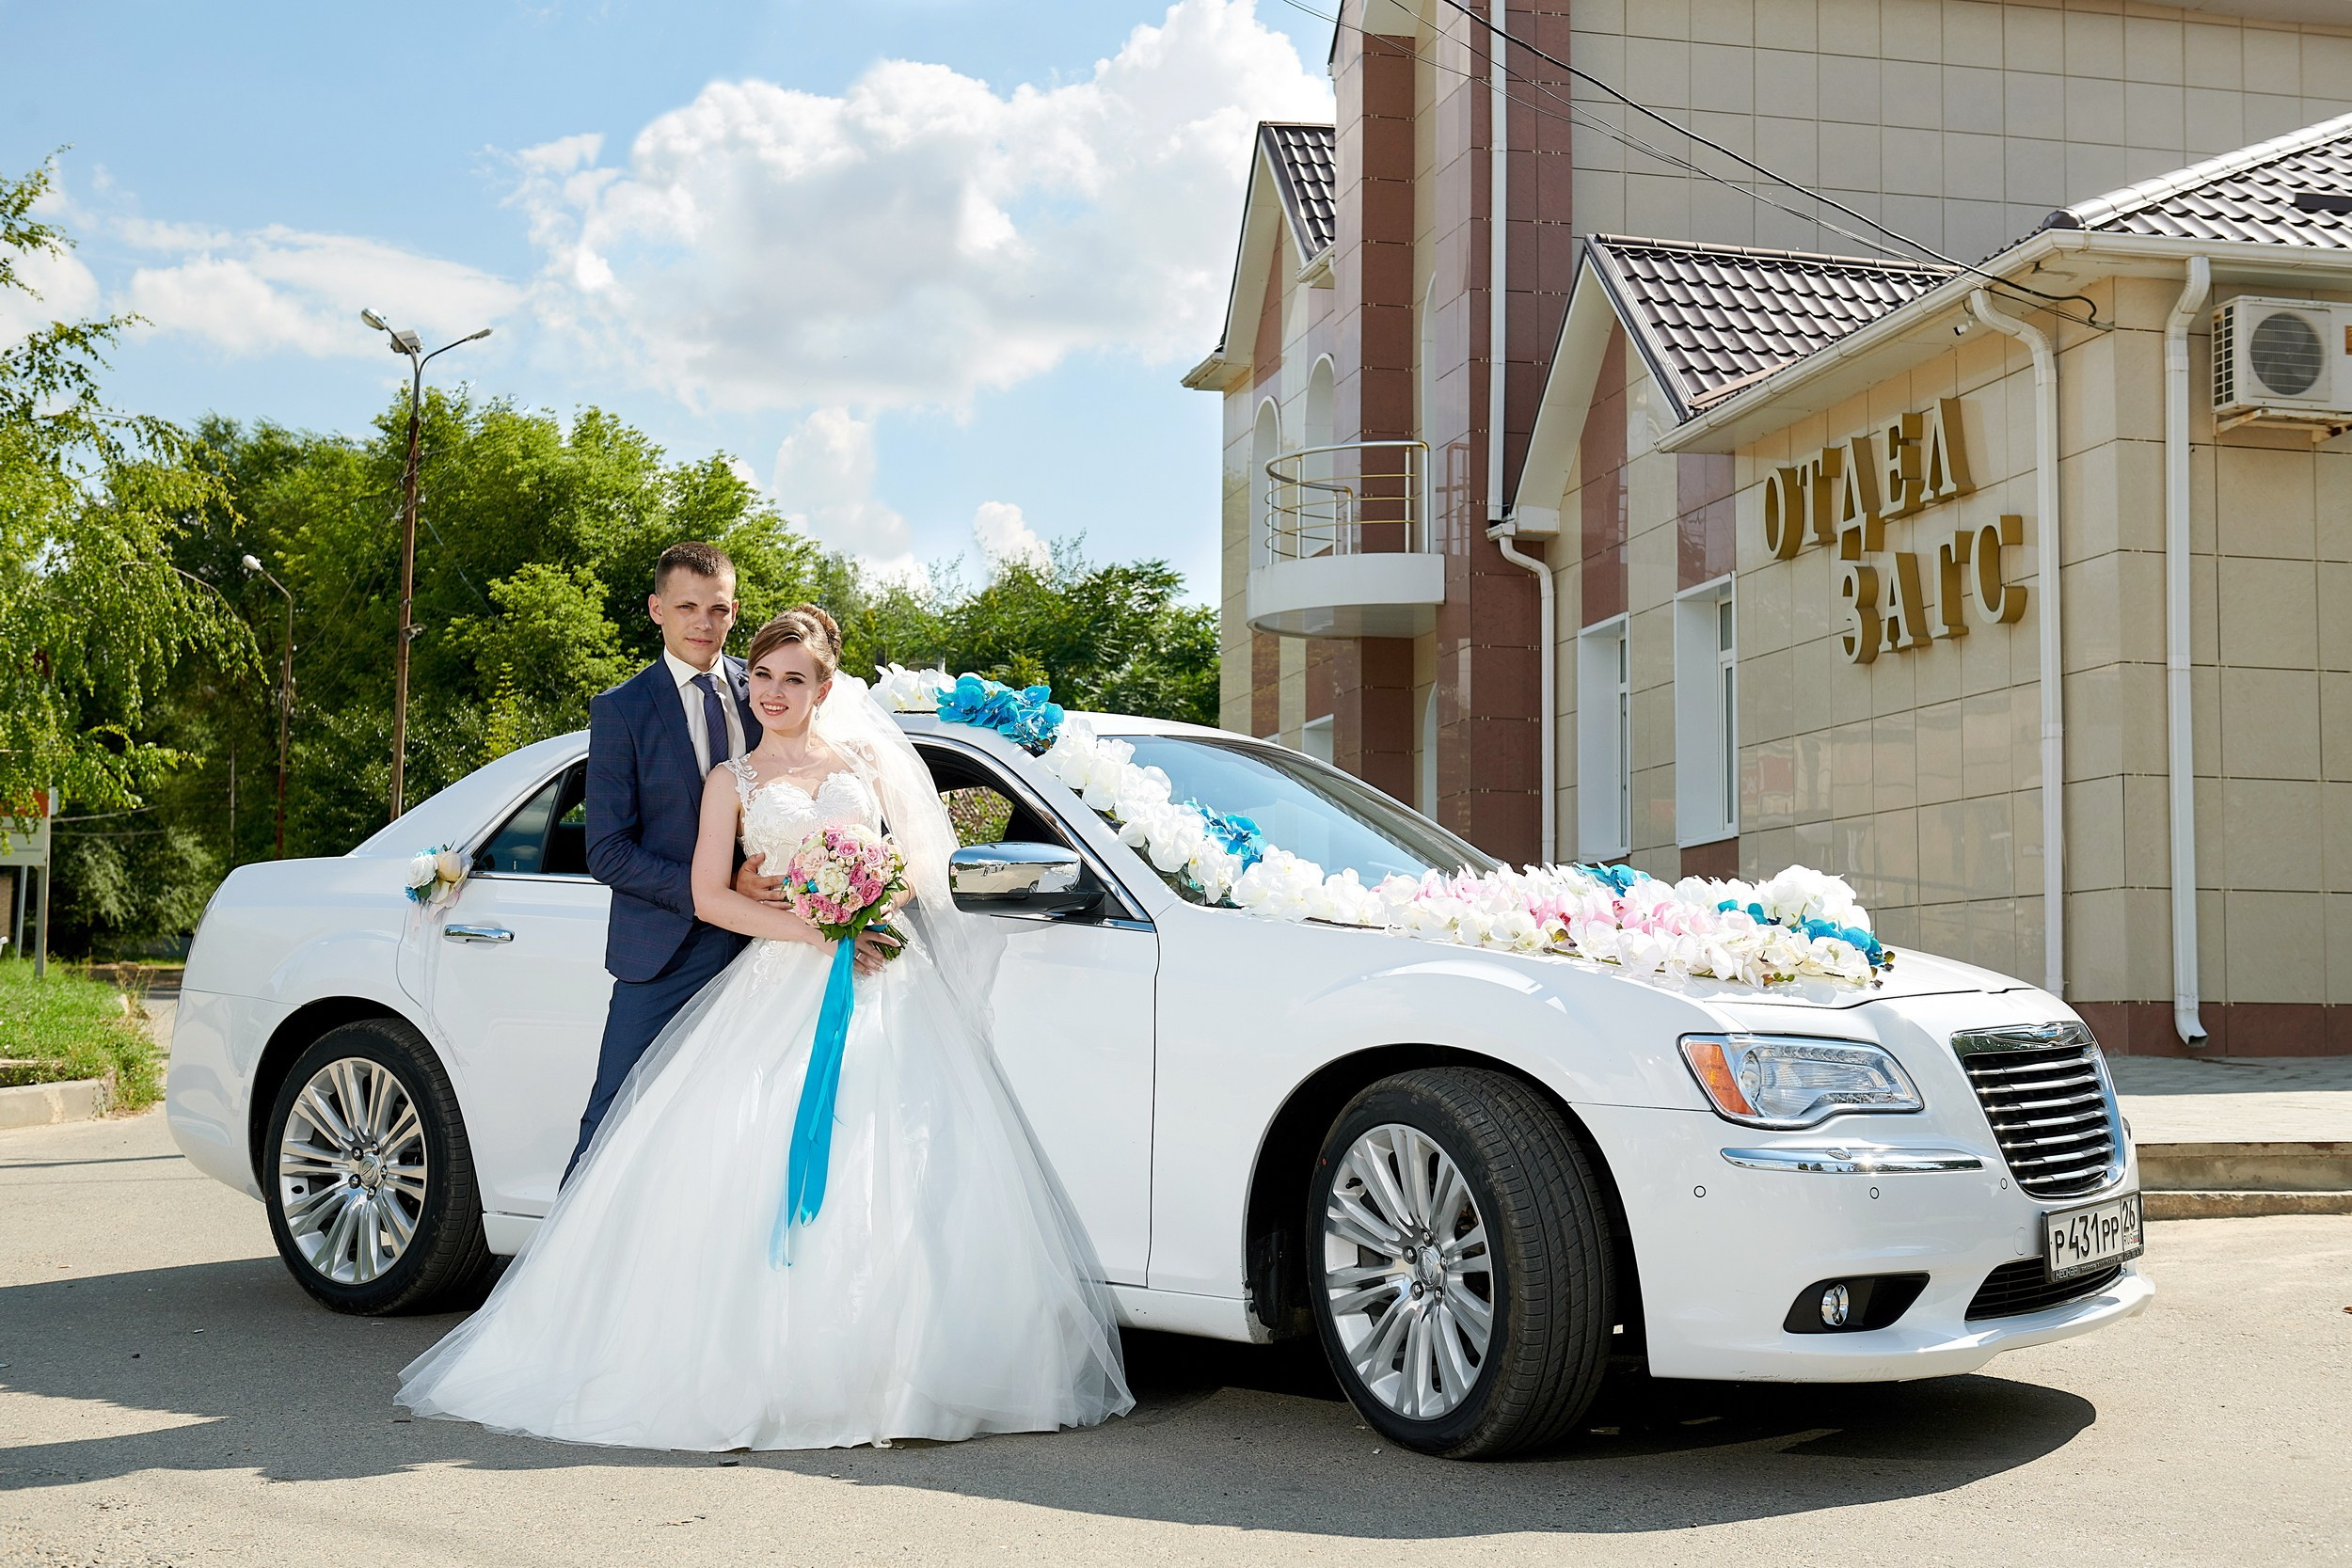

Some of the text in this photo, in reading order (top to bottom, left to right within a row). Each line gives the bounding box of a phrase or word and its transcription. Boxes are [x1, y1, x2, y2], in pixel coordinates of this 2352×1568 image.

[1765, 398, 1974, 561] ОТДЕЛ
[1842, 515, 2027, 664] ЗАГС
[2122, 1198, 2136, 1233] 26
[2123, 1233, 2134, 1245] RUS
